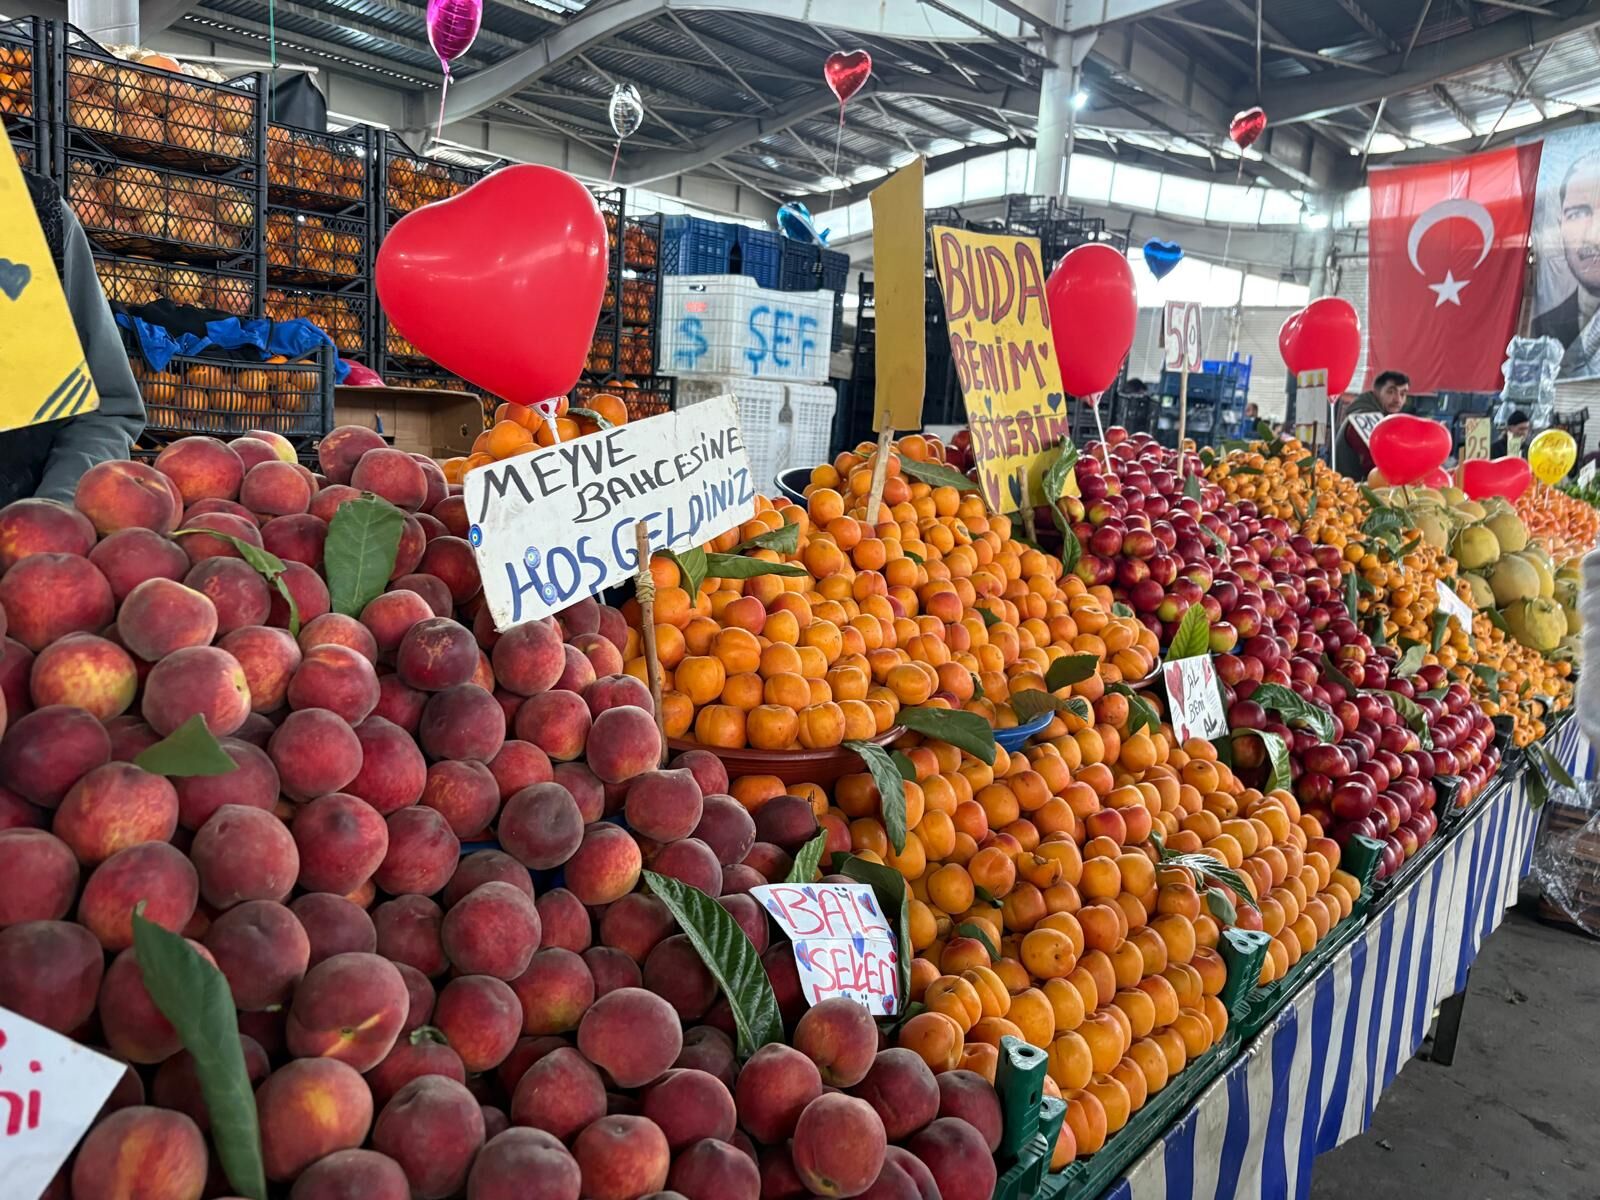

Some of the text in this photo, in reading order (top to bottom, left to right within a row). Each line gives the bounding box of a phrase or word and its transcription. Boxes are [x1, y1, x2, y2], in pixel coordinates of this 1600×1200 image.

[941, 232, 1050, 329] BUDA
[951, 332, 1047, 395] BENİM
[1167, 302, 1202, 372] 50
[479, 428, 637, 523] MEYVE
[611, 467, 756, 571] GELDİNİZ
[769, 887, 887, 937] BAL
